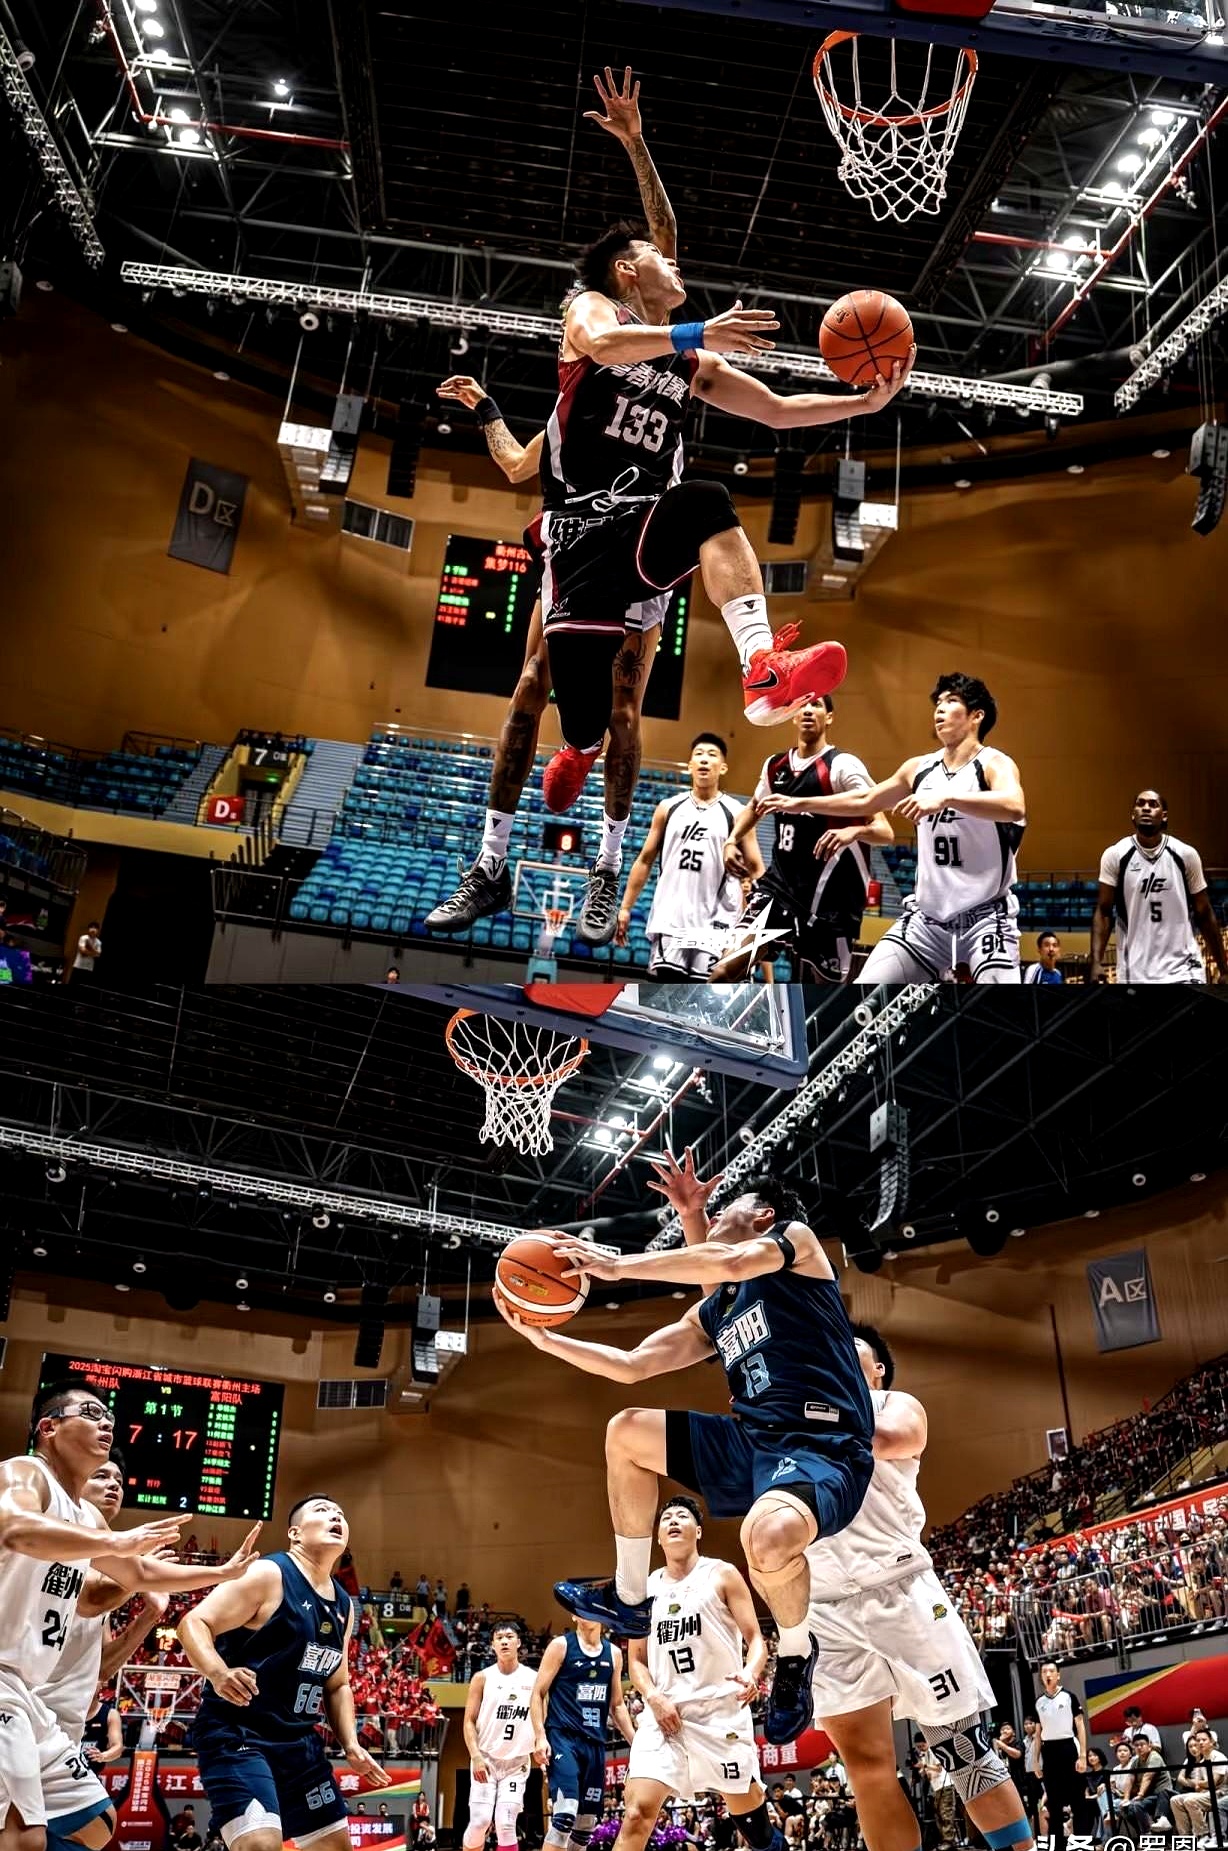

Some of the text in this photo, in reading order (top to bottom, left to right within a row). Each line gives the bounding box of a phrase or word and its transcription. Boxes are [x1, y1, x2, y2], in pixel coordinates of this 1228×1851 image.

[604, 395, 669, 453] 133
[254, 747, 268, 765] 7
[778, 823, 796, 852] 18
[678, 848, 704, 872] 25
[934, 836, 962, 868] 91
[1150, 902, 1162, 922] 5
[716, 1300, 771, 1370] 富阳
[740, 1352, 772, 1399] 13
[210, 1390, 243, 1406] 富阳队
[129, 1424, 143, 1444] 7
[172, 1430, 198, 1450] 17
[179, 1496, 188, 1508] 2
[383, 1602, 394, 1618] 8
[656, 1613, 702, 1645] 衢州
[300, 1643, 343, 1676] 富阳
[668, 1646, 696, 1675] 13
[576, 1683, 608, 1702] 富阳
[928, 1668, 960, 1701] 31
[496, 1705, 530, 1721] 衢州
[503, 1724, 516, 1741] 9
[756, 1740, 798, 1768] 商量
[720, 1762, 740, 1779] 13
[305, 1780, 336, 1811] 66
[509, 1782, 517, 1792] 9
[584, 1786, 602, 1802] 93
